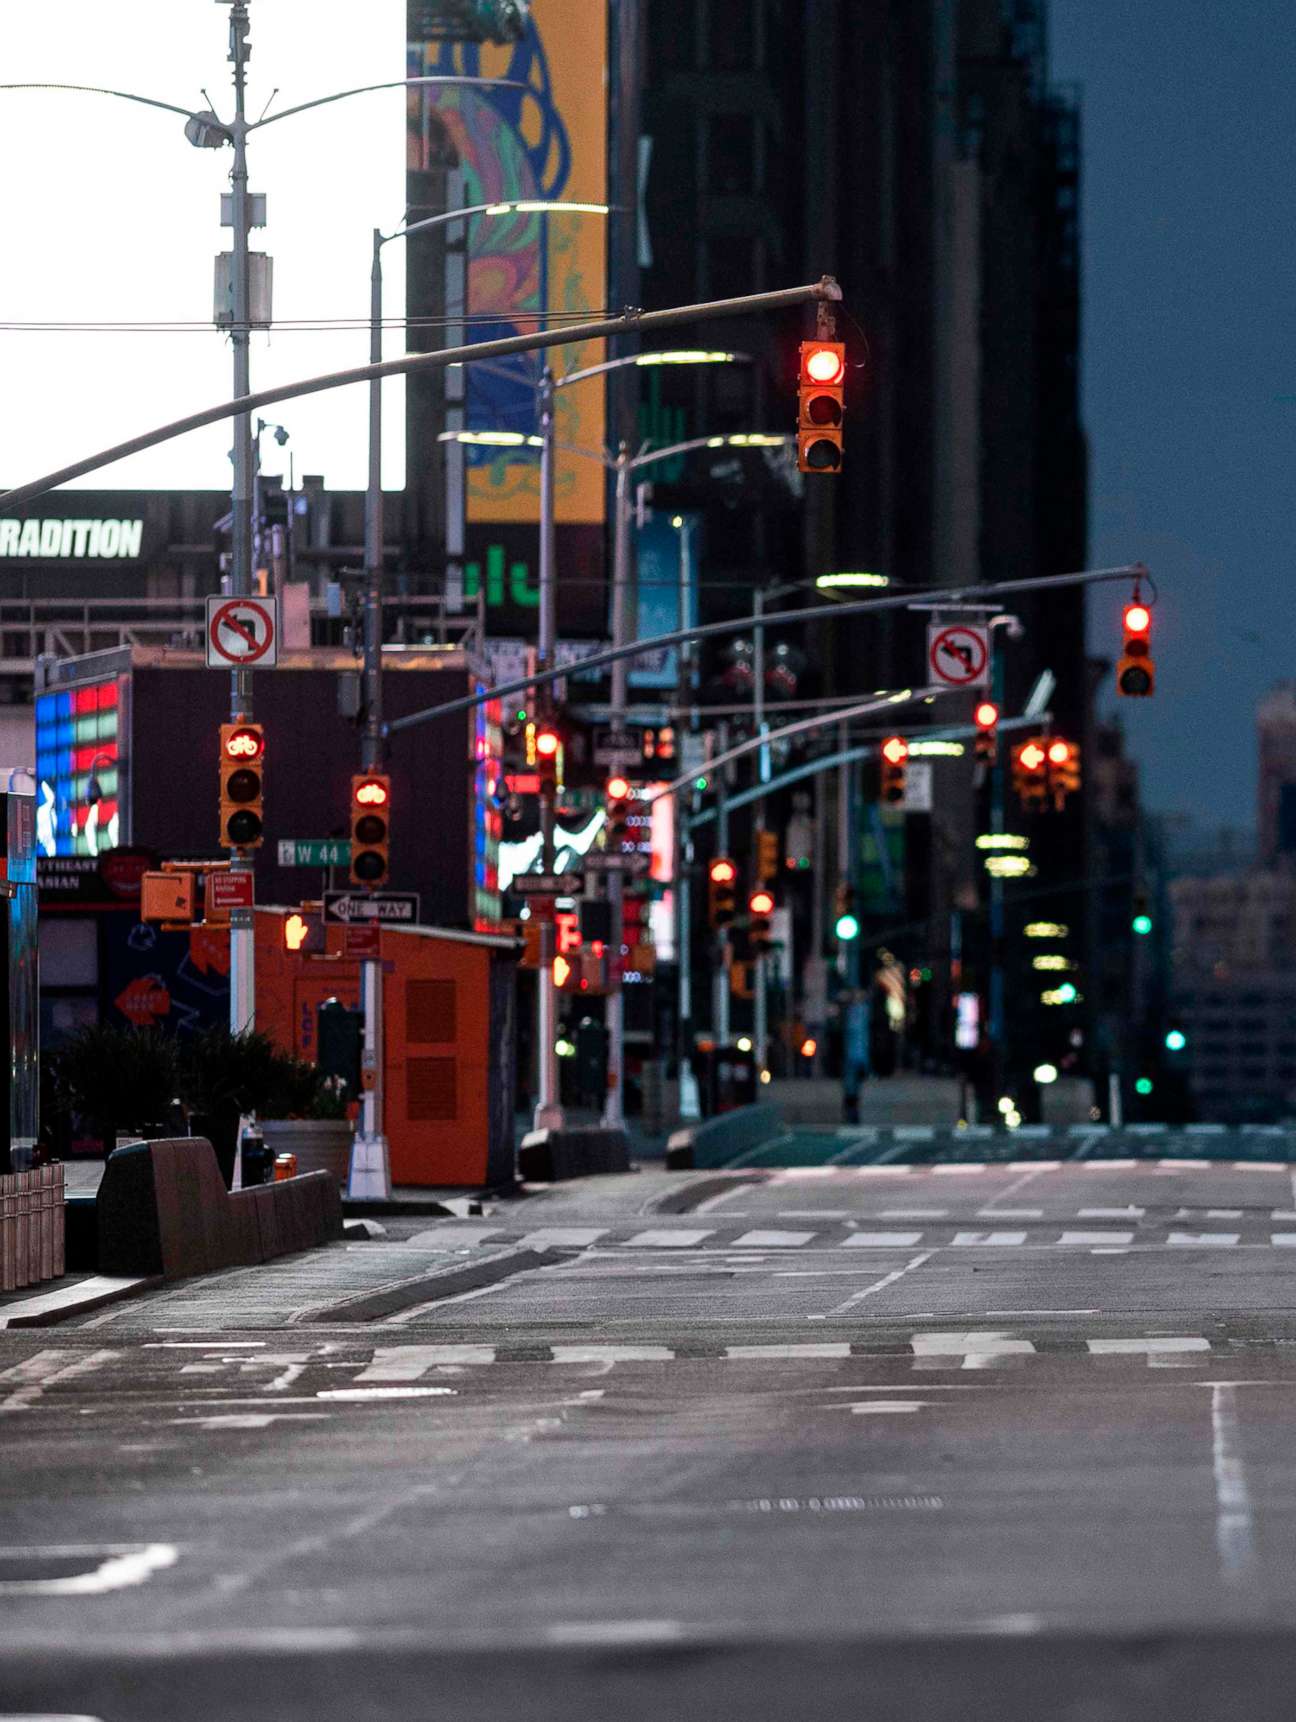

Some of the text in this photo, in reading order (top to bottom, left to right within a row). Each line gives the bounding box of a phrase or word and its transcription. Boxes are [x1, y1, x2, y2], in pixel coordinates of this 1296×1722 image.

[0, 518, 143, 558] RADITION
[298, 845, 339, 863] W 44
[337, 900, 406, 917] ONE WAY
